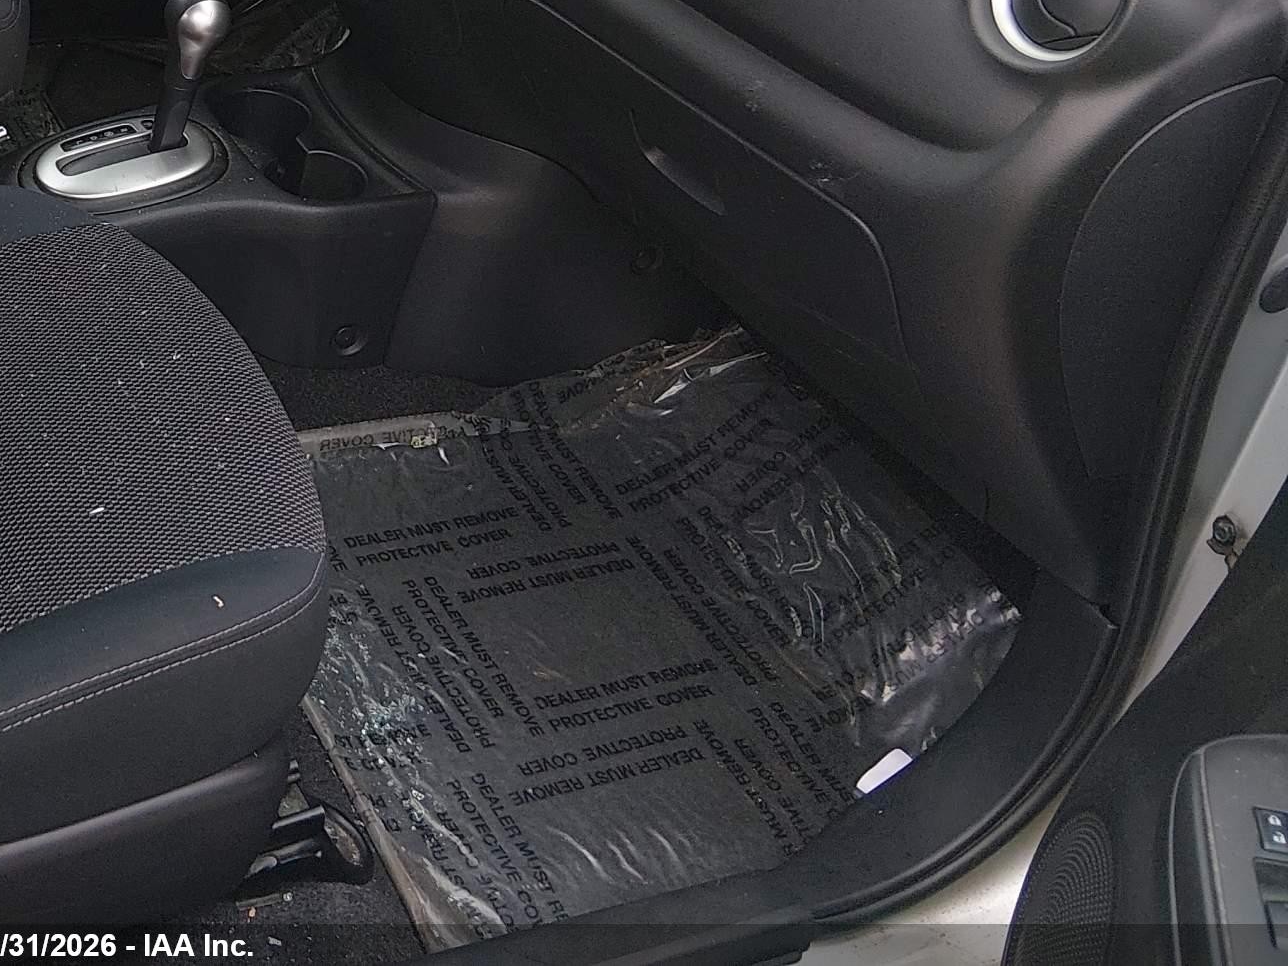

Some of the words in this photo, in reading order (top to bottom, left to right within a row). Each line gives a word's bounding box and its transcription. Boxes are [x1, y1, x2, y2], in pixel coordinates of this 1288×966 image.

[319, 434, 374, 451] COVER
[548, 464, 587, 506] COVER
[576, 465, 623, 519] REMOVE
[615, 463, 674, 495] DEALER
[628, 456, 722, 512] PROTECTIVE
[343, 528, 407, 549] DEALER
[406, 519, 452, 539] MUST
[452, 506, 519, 529] REMOVE
[507, 482, 552, 532] DEALER
[355, 540, 455, 567] PROTECTIVE
[456, 527, 514, 549] COVER
[466, 559, 521, 580] COVER
[525, 541, 621, 572] PROTECTIVE
[572, 557, 635, 581] DEALER
[625, 535, 677, 592] REMOVE
[663, 548, 705, 594] COVER
[456, 578, 527, 604] REMOVE
[527, 570, 574, 590] MUST
[355, 583, 402, 648] REMOVE
[392, 605, 432, 655] COVER
[671, 592, 711, 632] MUST
[401, 579, 467, 665] PROTECTIVE
[463, 666, 505, 718] COVER
[423, 575, 469, 631] DEALER
[462, 631, 500, 671] MUST
[492, 672, 546, 738] REMOVE
[700, 595, 780, 682] PROTECTIVE
[705, 632, 759, 686] DEALER
[426, 653, 496, 749] PROTECTIVE
[533, 685, 599, 710] DEALER
[599, 674, 649, 696] MUST
[647, 657, 718, 685] REMOVE
[548, 696, 654, 733] PROTECTIVE
[655, 683, 716, 707] COVER
[423, 692, 472, 753] DEALER
[580, 724, 688, 761] PROTECTIVE
[768, 701, 822, 765] DEALER
[517, 752, 579, 776] COVER
[589, 761, 639, 789] MUST
[637, 746, 706, 775] DEALER
[693, 718, 752, 786] REMOVE
[734, 737, 782, 792] COVER
[747, 707, 831, 804] PROTECTIVE
[509, 776, 586, 807] REMOVE
[447, 779, 523, 883] PROTECTIVE
[471, 772, 522, 838] DEALER
[515, 842, 556, 894] MUST
